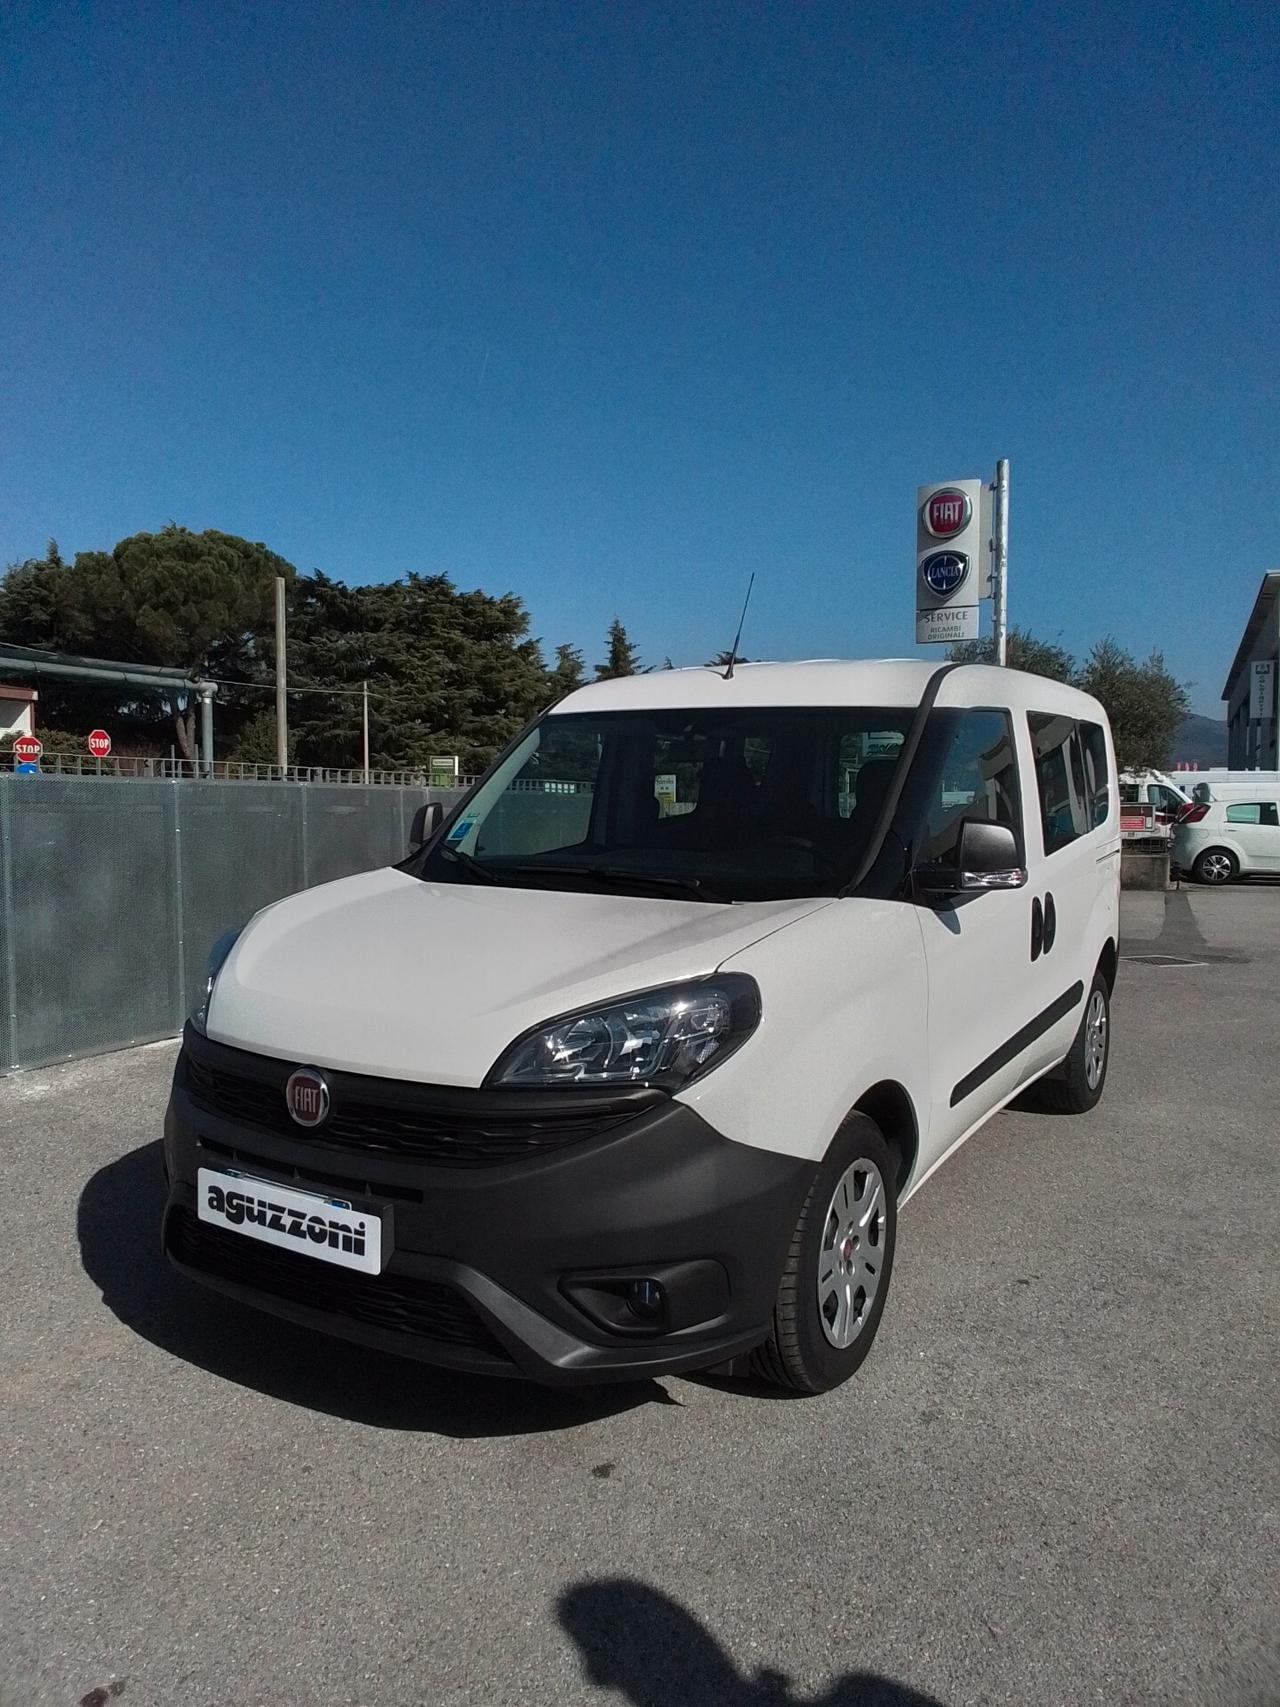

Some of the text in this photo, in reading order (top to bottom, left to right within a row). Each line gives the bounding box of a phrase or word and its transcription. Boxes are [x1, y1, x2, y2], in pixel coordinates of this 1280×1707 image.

[933, 501, 962, 521] FIAT
[931, 566, 959, 578] LANCIA
[925, 610, 969, 623] SERVICE
[930, 625, 962, 633] RICAMBI
[928, 632, 965, 640] ORIGINALI
[15, 745, 40, 754] STOP
[90, 739, 109, 749] STOP
[294, 1086, 319, 1113] FIAT
[207, 1185, 366, 1256] aguzzoni
